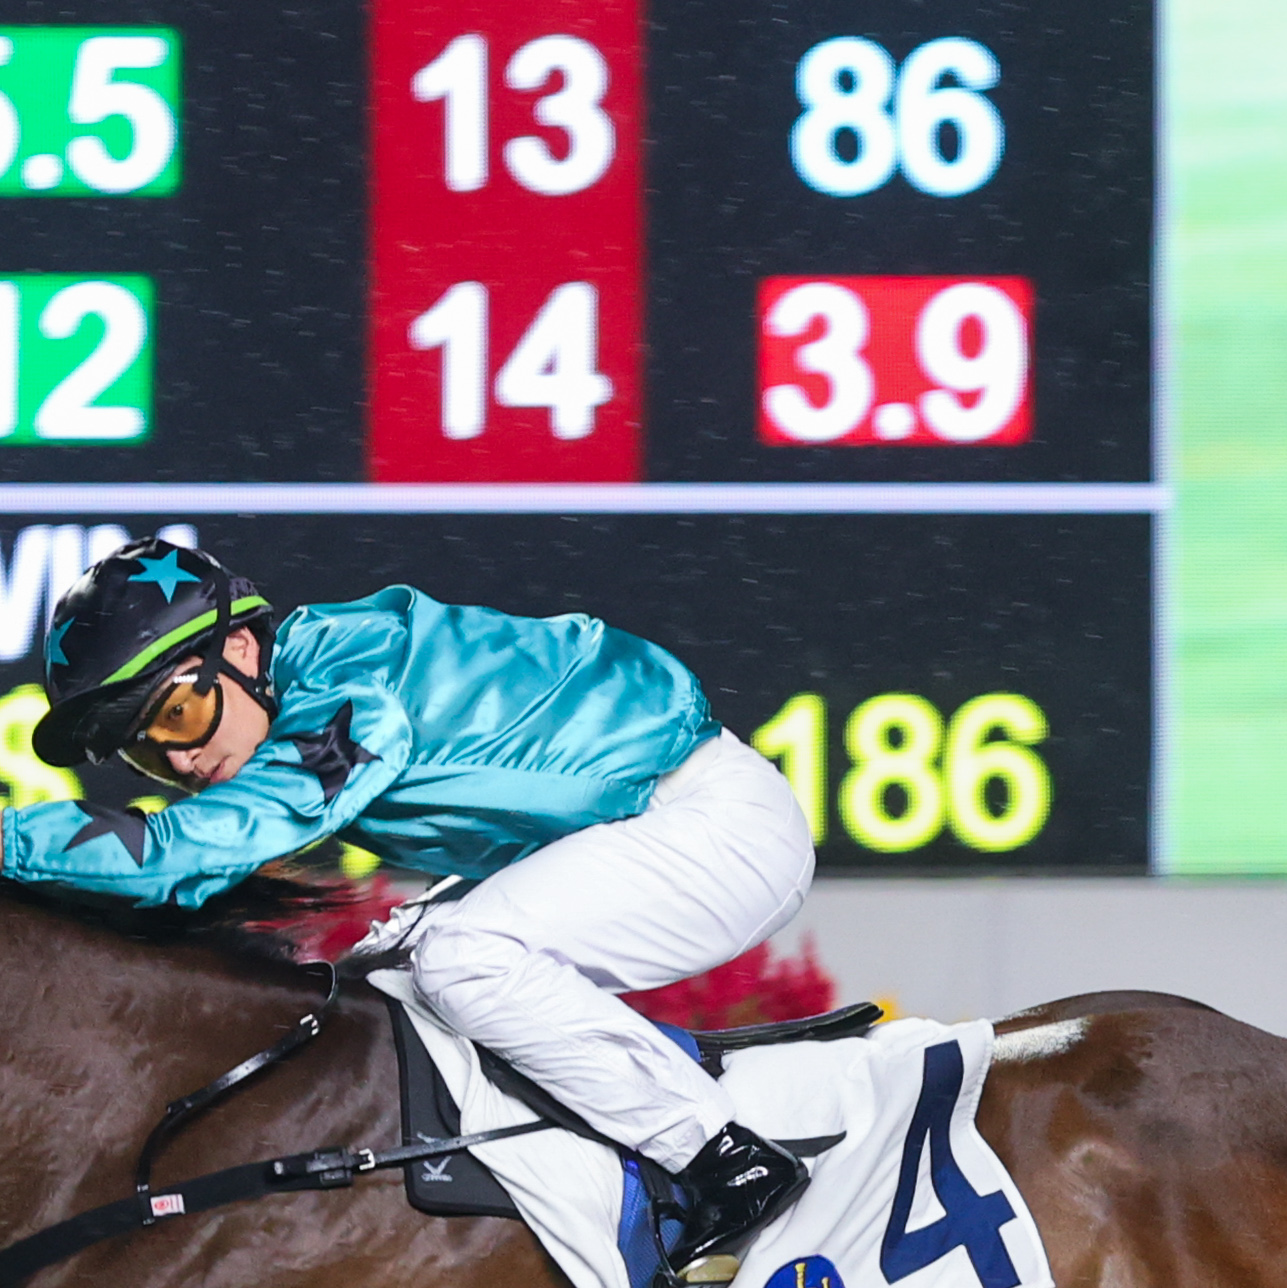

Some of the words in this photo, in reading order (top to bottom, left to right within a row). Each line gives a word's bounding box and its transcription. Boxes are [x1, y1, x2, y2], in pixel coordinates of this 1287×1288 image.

[410, 33, 616, 196] 13
[790, 36, 1005, 196] 86
[409, 280, 614, 440] 14
[762, 281, 1029, 442] 3.9
[750, 691, 1053, 854] 186
